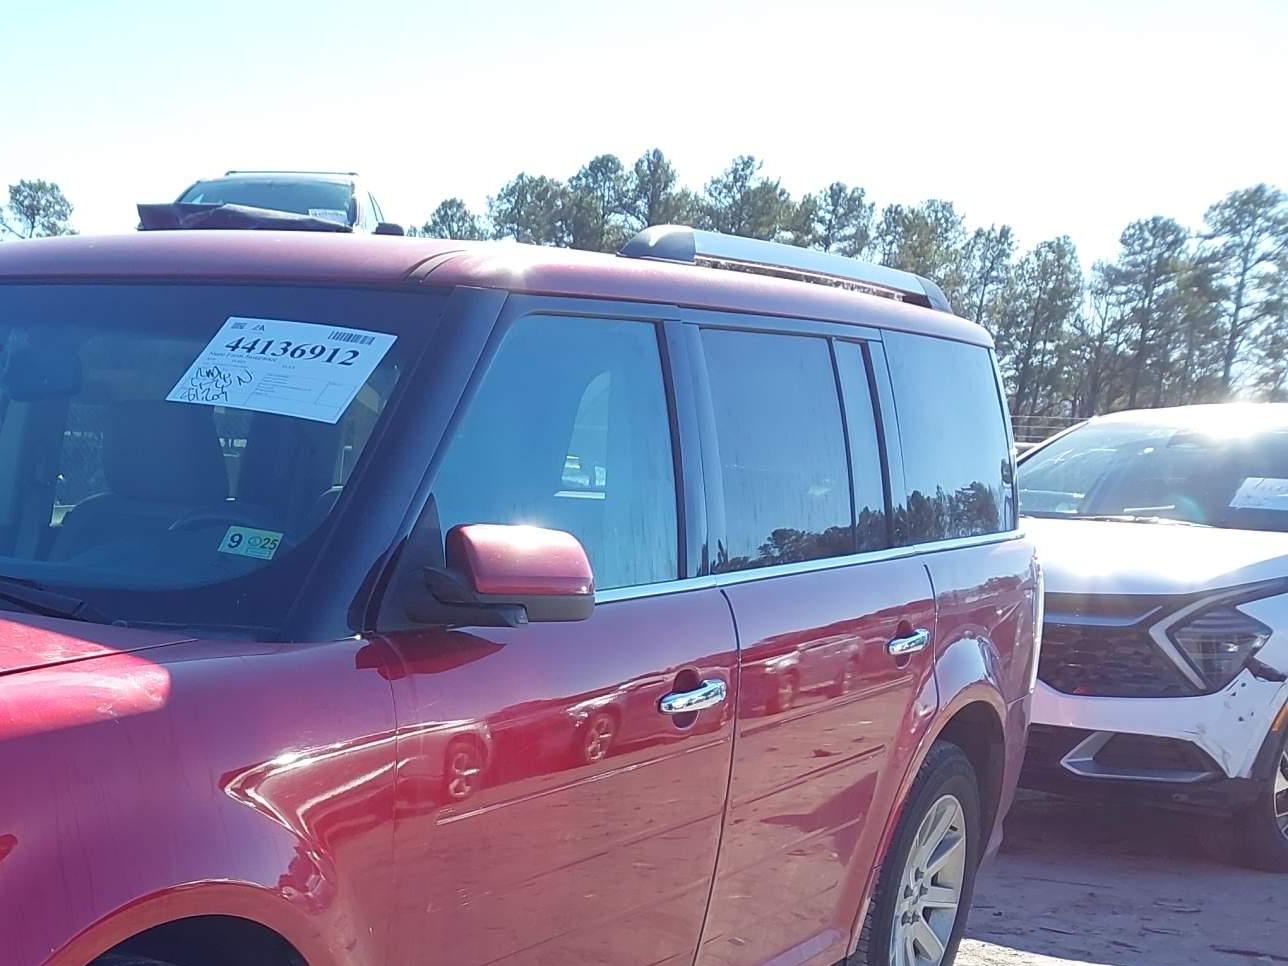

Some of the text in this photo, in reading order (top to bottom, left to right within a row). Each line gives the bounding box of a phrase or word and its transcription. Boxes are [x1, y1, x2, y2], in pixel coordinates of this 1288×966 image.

[224, 336, 361, 366] 44136912
[227, 533, 279, 551] 9 25
